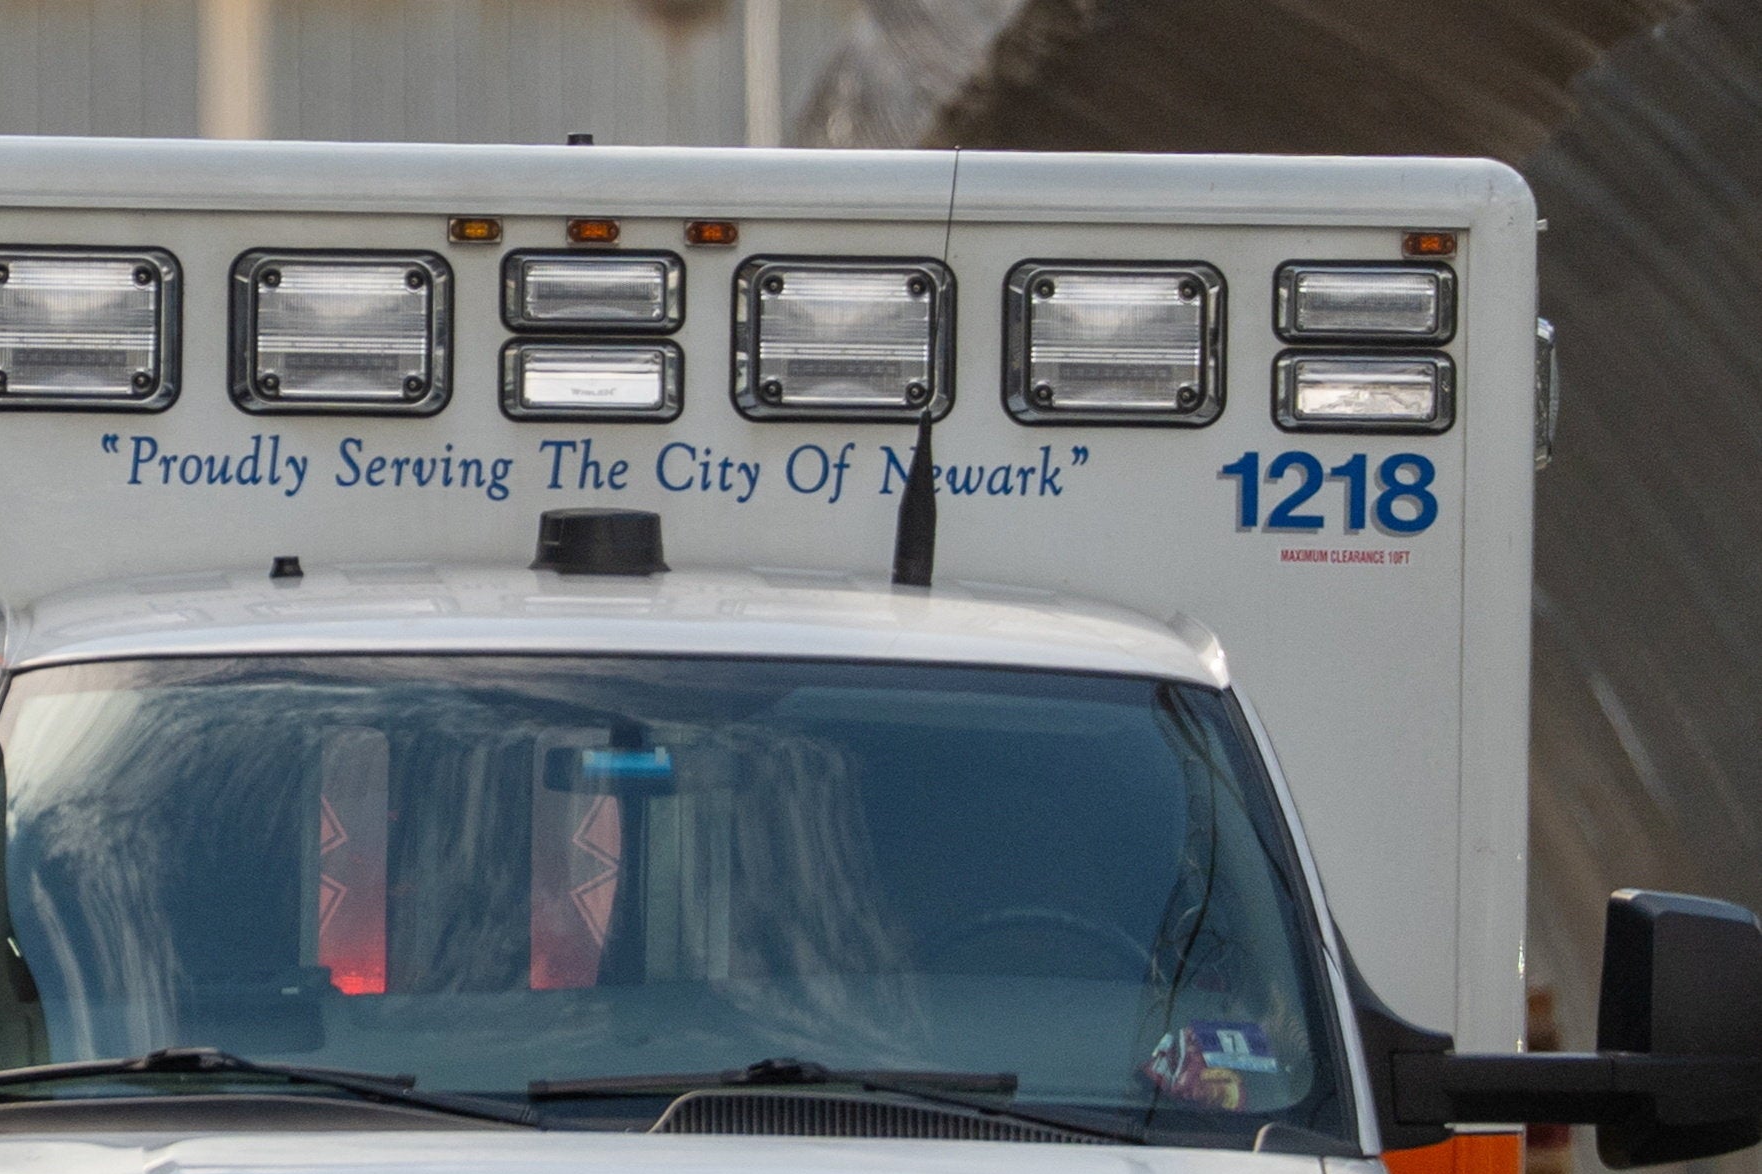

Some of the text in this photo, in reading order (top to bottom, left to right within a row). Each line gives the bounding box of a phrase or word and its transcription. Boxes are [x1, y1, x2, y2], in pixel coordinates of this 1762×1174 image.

[335, 437, 513, 500] Serving
[539, 438, 629, 490] The
[656, 442, 760, 503] City
[786, 442, 855, 503] Of
[1216, 450, 1438, 537] 1218
[1280, 549, 1328, 563] MAXIMUM
[1330, 551, 1384, 564] CLEARANCE
